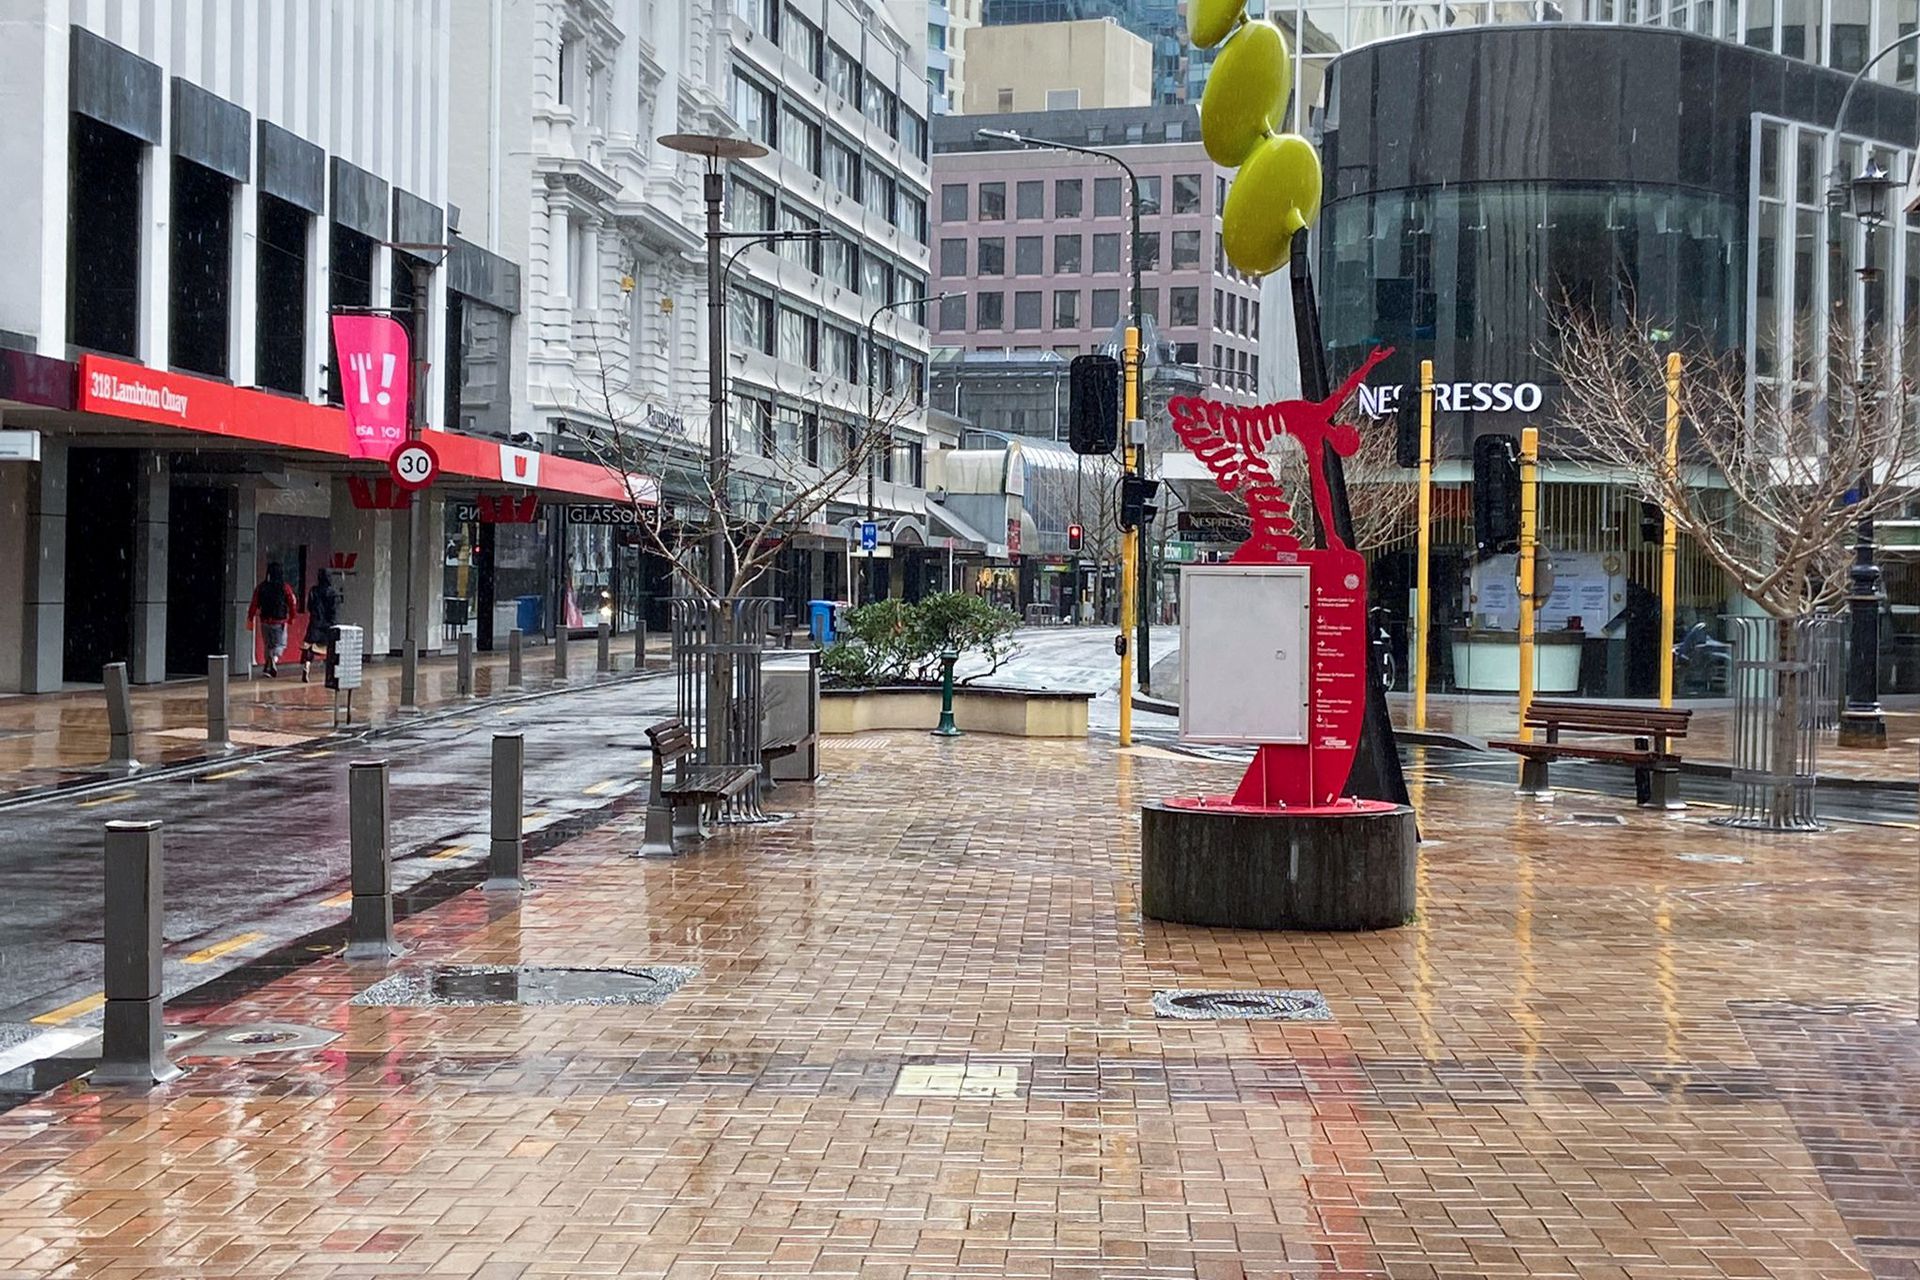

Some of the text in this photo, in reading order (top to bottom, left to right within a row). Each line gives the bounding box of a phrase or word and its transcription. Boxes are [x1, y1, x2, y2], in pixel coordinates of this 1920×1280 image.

[91, 371, 189, 419] 318 Lambton Quay
[401, 455, 429, 475] 30
[570, 507, 656, 524] GLASSONS
